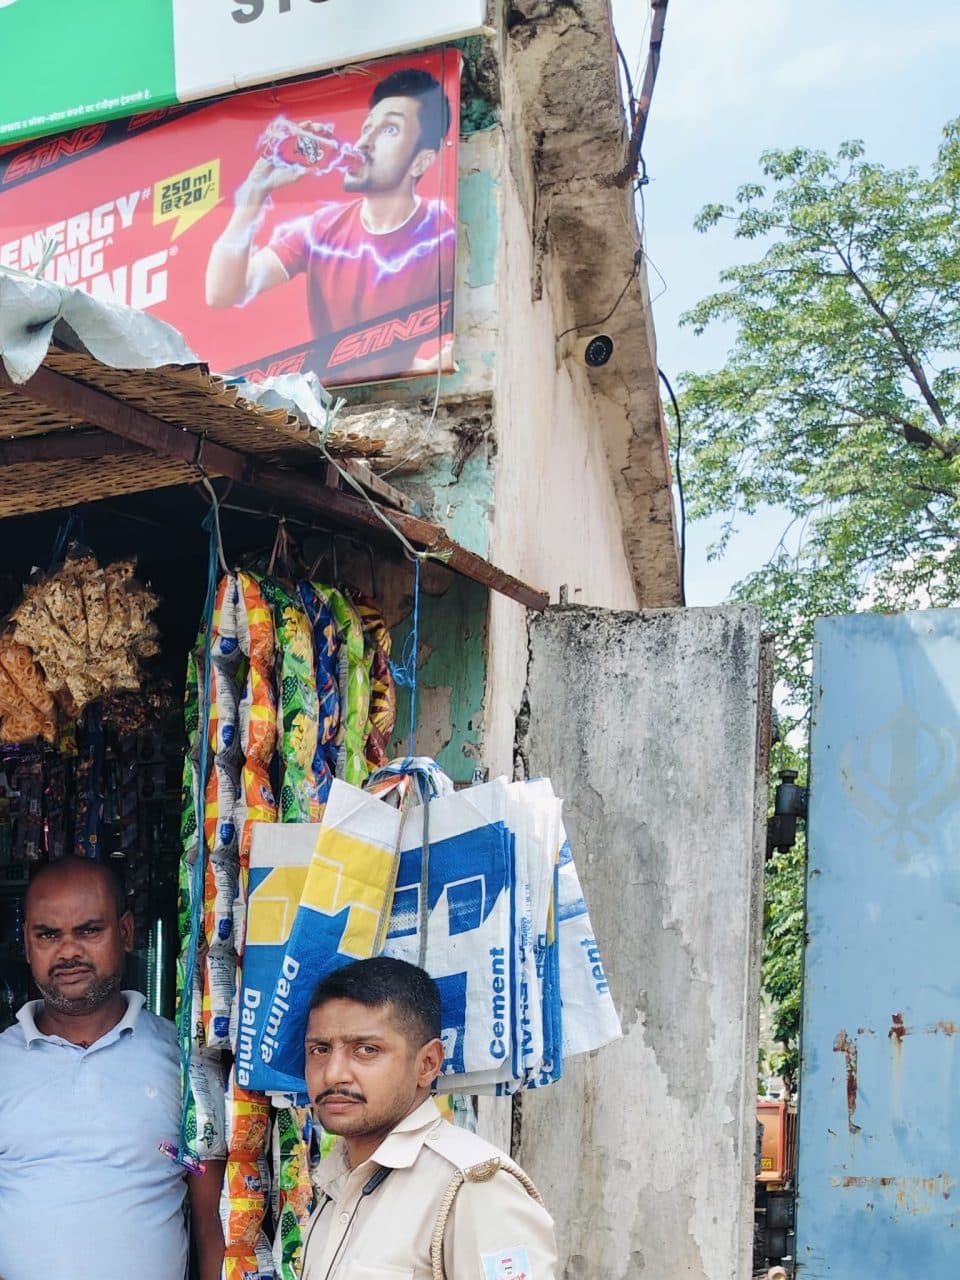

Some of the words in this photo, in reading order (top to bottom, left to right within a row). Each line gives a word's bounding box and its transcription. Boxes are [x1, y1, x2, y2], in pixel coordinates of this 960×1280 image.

[2, 124, 108, 184] STING
[162, 176, 190, 200] 250
[193, 169, 212, 187] ml
[327, 300, 451, 368] STING
[238, 987, 261, 1086] Dalmia
[260, 954, 300, 1064] Dalmia
[490, 947, 506, 1059] Cement
